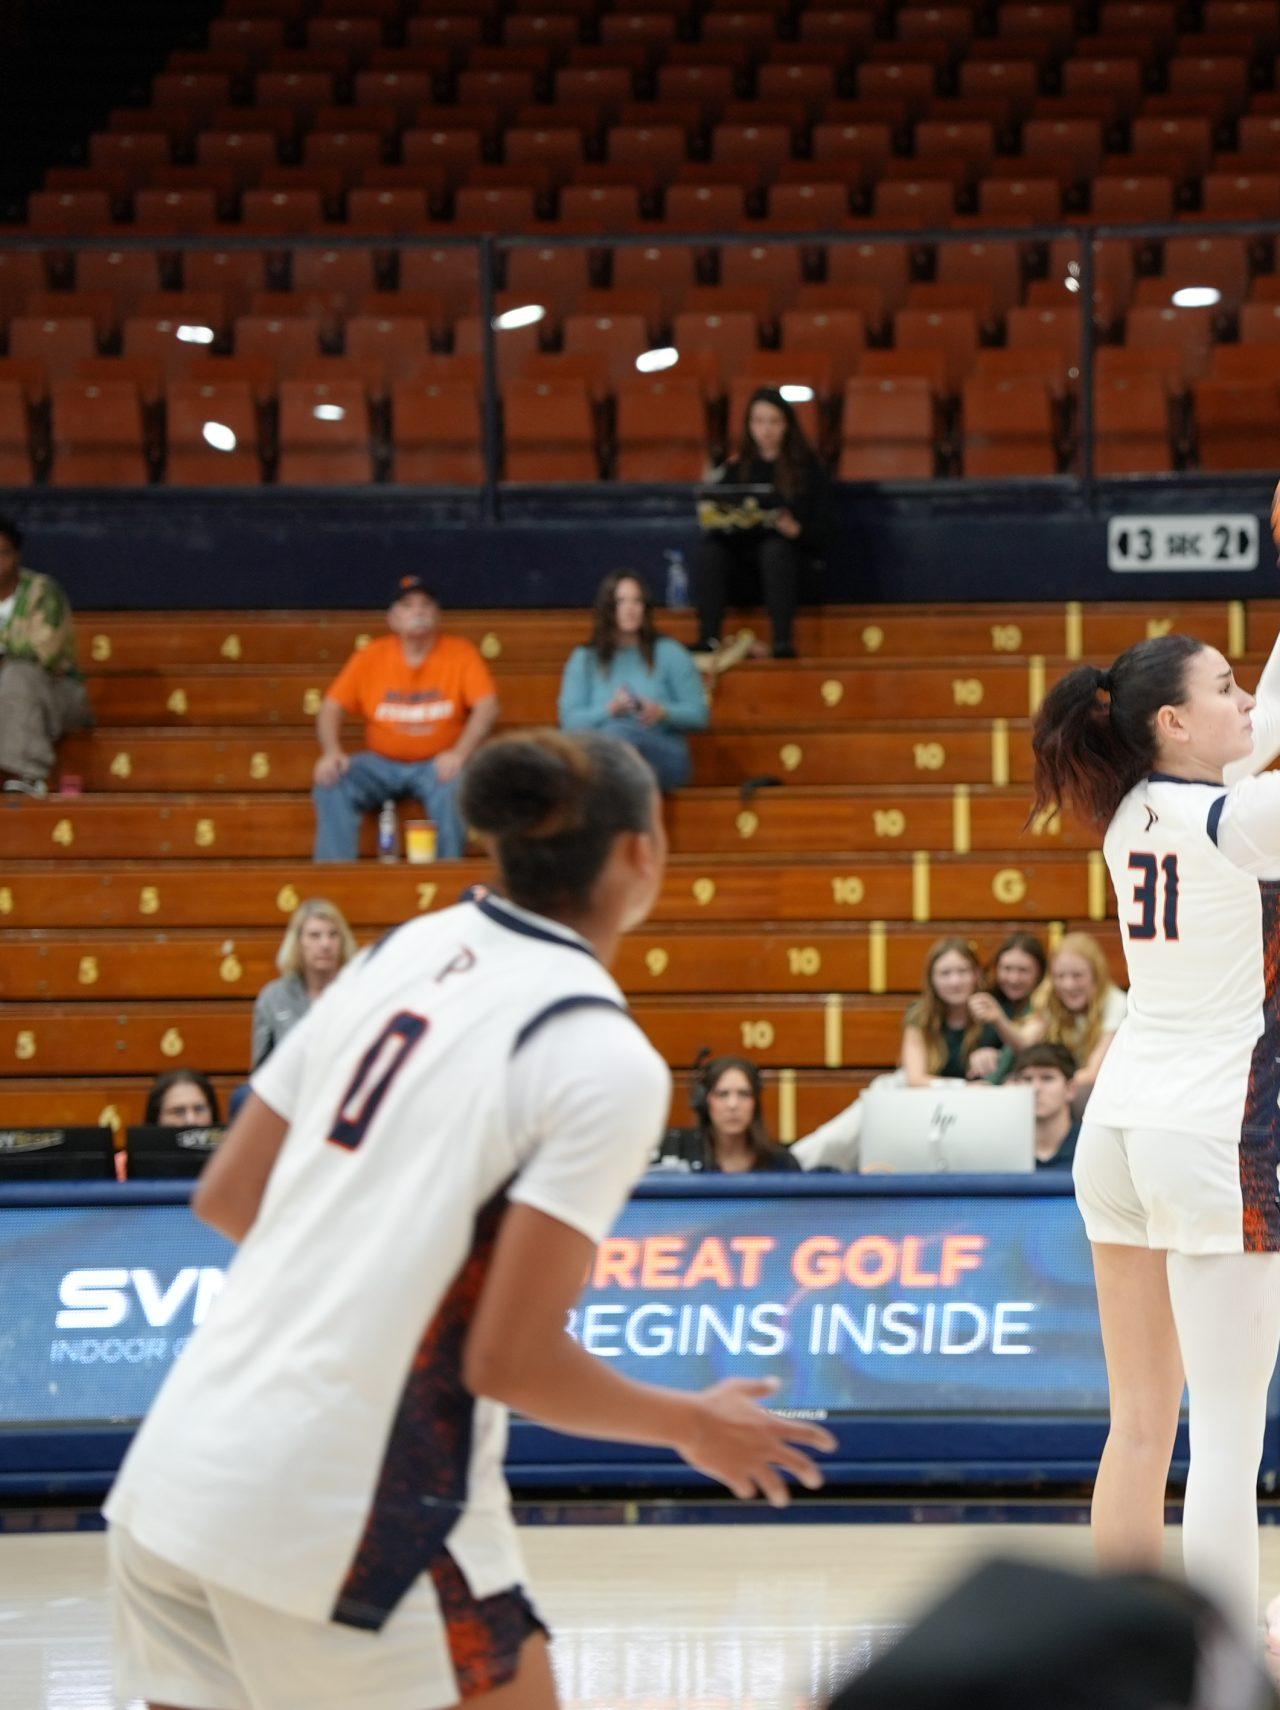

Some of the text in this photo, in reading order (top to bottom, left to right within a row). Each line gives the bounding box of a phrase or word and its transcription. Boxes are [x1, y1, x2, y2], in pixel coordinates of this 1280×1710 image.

[1136, 525, 1230, 561] 3 SEC 2
[221, 634, 242, 660] 4
[862, 626, 884, 652] 9
[991, 625, 1022, 651] 10
[167, 688, 188, 715] 4
[820, 679, 844, 707] 9
[952, 679, 984, 707] 10
[109, 752, 132, 779] 4
[249, 752, 270, 779] 5
[780, 742, 801, 771] 9
[912, 742, 946, 771] 10
[52, 819, 75, 847] 4
[194, 818, 216, 847] 5
[736, 811, 759, 839] 9
[872, 808, 905, 838] 10
[139, 886, 160, 915] 5
[277, 883, 299, 912] 6
[417, 882, 438, 910] 7
[692, 877, 715, 906] 9
[831, 876, 865, 905] 10
[993, 868, 1027, 904] G
[1127, 851, 1181, 942] 31
[79, 956, 99, 985] 5
[220, 955, 243, 983] 6
[645, 947, 669, 977] 9
[786, 946, 821, 976] 10
[16, 1029, 36, 1060] 5
[160, 1027, 184, 1057] 6
[740, 1020, 774, 1049] 10
[326, 1009, 431, 1152] 0
[585, 1236, 985, 1289] REAT GOLF
[809, 1302, 1040, 1356] INSIDE
[50, 1338, 167, 1364] INDOOR
